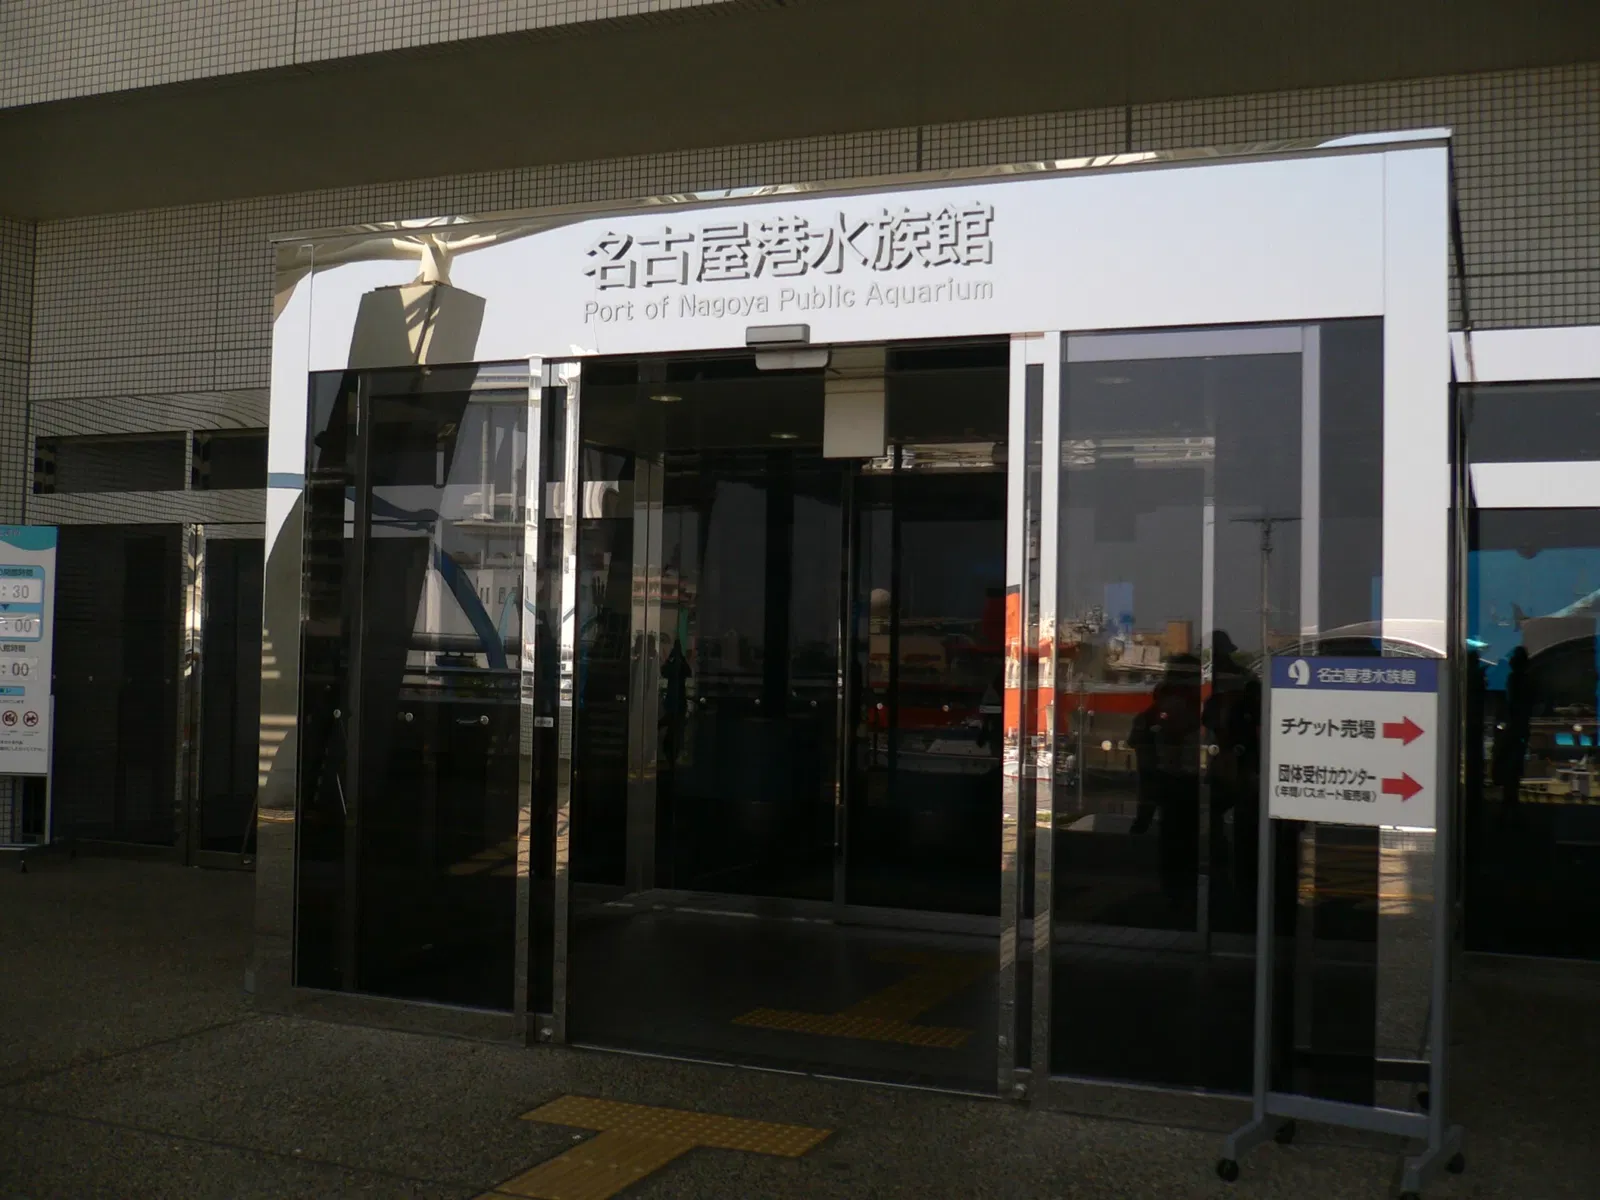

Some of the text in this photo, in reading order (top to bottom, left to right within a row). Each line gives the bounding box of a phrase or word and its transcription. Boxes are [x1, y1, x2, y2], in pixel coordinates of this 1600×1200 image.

[583, 201, 995, 291] 名古屋港水族館
[584, 277, 994, 324] Port of Nagoya Public Aquarium
[1317, 667, 1416, 685] 名古屋港水族館
[1281, 717, 1376, 740] チケット売場
[1278, 763, 1377, 786] 団体受付カウンター
